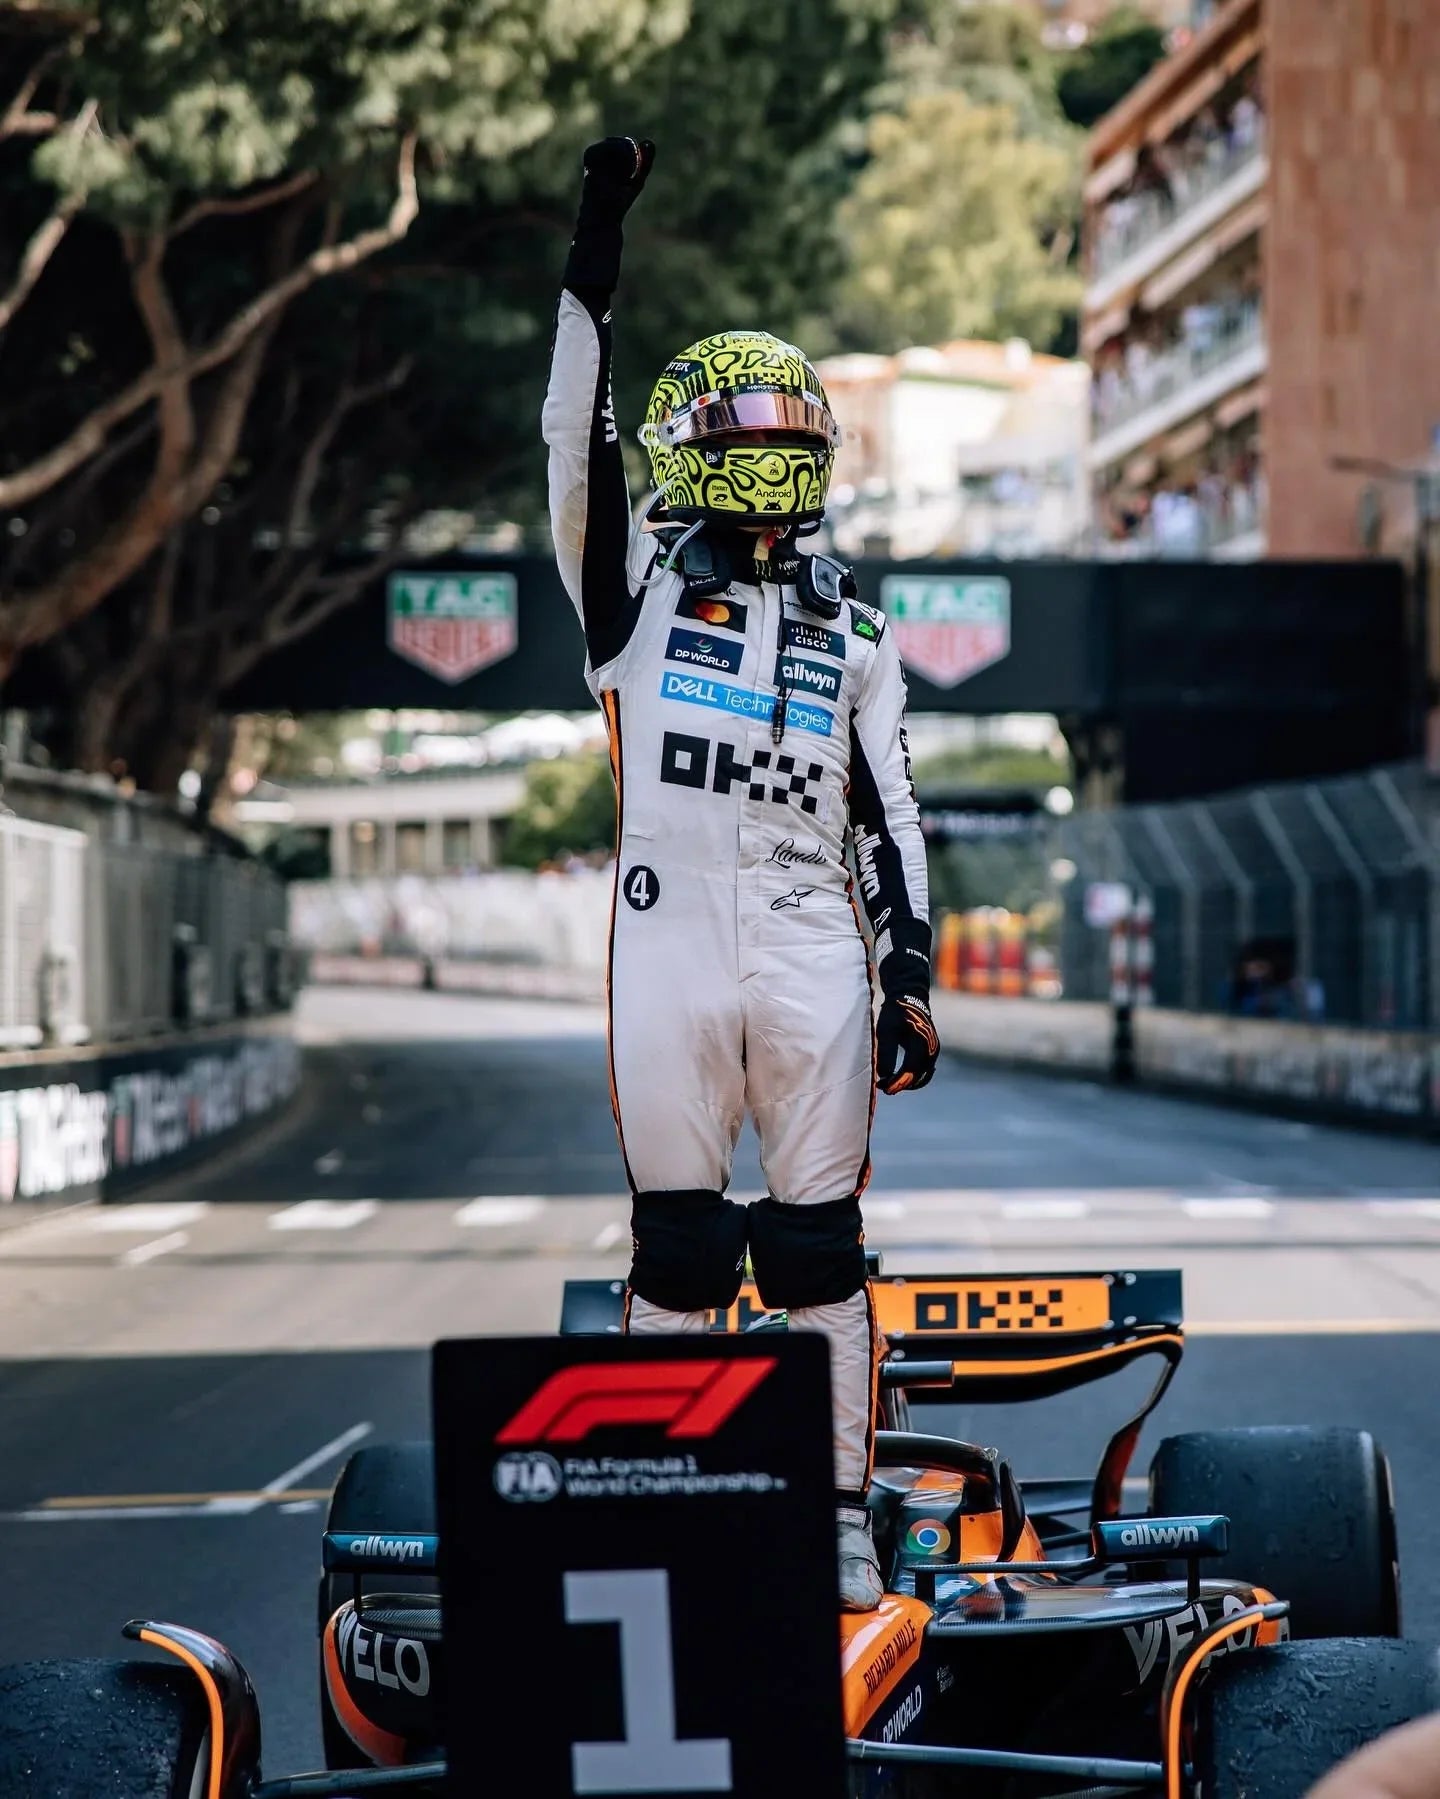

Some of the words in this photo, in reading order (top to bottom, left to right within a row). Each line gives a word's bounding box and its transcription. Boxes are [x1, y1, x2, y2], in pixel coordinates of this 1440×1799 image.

[755, 489, 792, 498] Android
[675, 649, 692, 660] DP
[693, 651, 730, 668] WORLD
[782, 663, 836, 691] allwyn
[667, 676, 718, 702] DELL
[723, 687, 828, 730] Technlogies
[630, 870, 650, 907] 4
[495, 1355, 779, 1443] F1
[499, 1460, 557, 1496] FIA
[350, 1535, 424, 1561] allwyn
[1121, 1523, 1199, 1549] allwyn
[339, 1608, 430, 1697] VELO
[863, 1643, 897, 1697] RICHARD
[893, 1618, 917, 1659] MILLE
[563, 1568, 733, 1795] 1
[892, 1684, 922, 1739] WORLD
